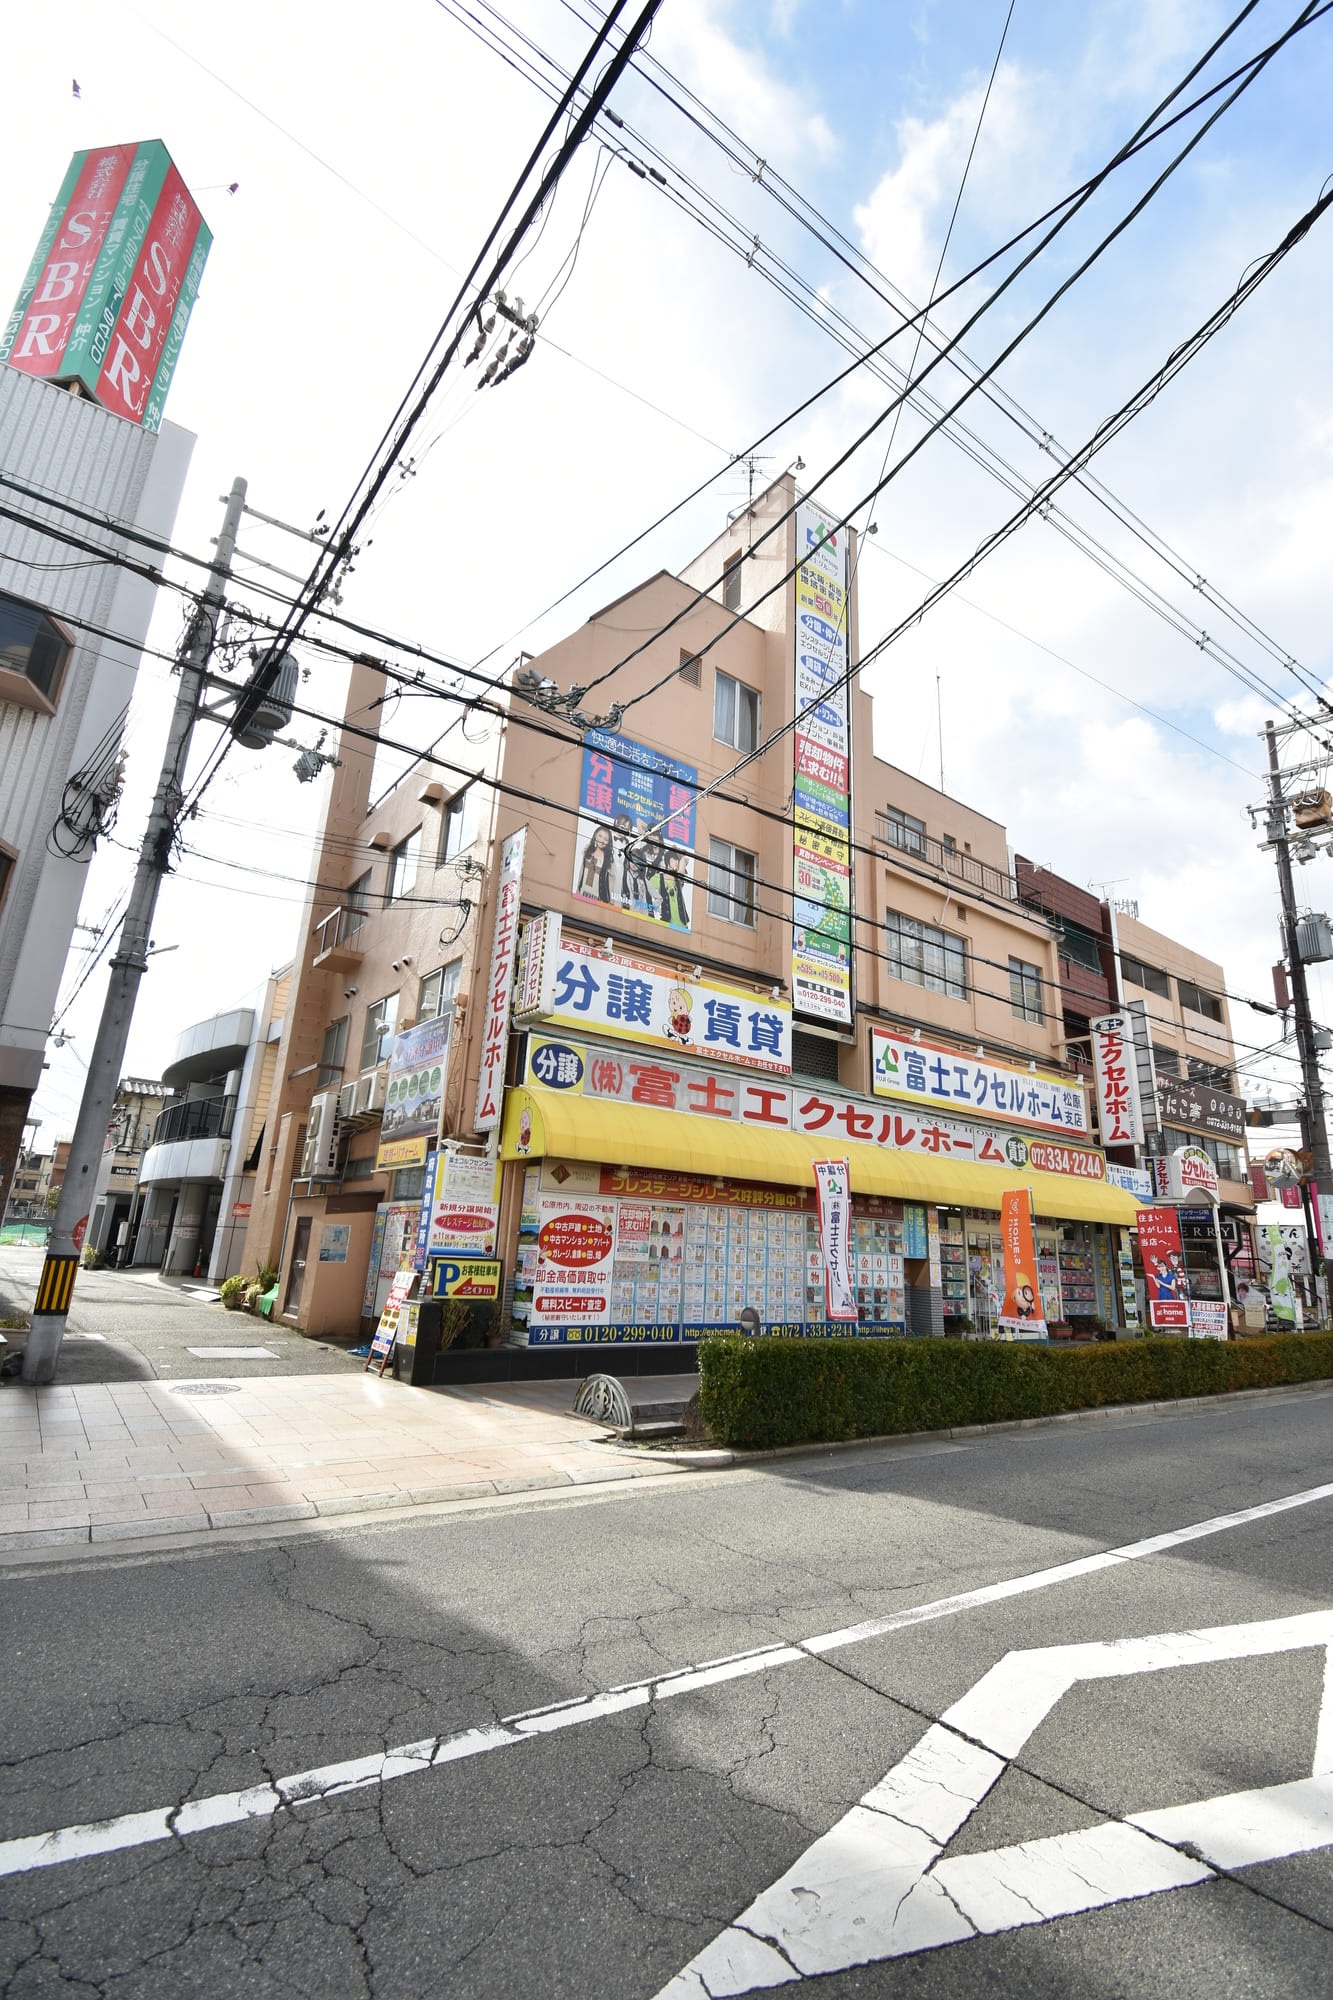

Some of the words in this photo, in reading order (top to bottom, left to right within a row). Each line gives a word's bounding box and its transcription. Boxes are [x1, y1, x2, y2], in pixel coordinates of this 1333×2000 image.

[14, 210, 97, 359] SBR
[105, 241, 171, 411] SBR
[801, 565, 842, 597] 南大阪・松原
[591, 730, 694, 782] 快適生活をデザイン
[799, 739, 844, 773] 売却物件
[586, 753, 613, 814] 分譲
[627, 790, 652, 806] エクセル
[798, 836, 845, 861] 秘密厳守
[798, 869, 812, 890] 30
[527, 919, 543, 1007] 富士エクセル
[479, 879, 518, 1120] 富士エクセルホーム
[556, 960, 654, 1026] 分譲
[703, 999, 784, 1058] 賃貸
[1100, 1019, 1121, 1031] 富士
[537, 1048, 578, 1085] 分譲
[695, 1046, 791, 1074] 富士エクセルホームにお任せ下さい
[904, 1050, 1063, 1122] 富士エクセルホーム
[1099, 1031, 1131, 1141] エクセルホーム
[1063, 1091, 1082, 1110] 松原
[917, 1117, 961, 1131] EXCEL
[965, 1127, 1001, 1140] HOME
[1064, 1110, 1083, 1128] 支店
[1008, 1140, 1027, 1163] 賃貸
[1180, 1159, 1216, 1181] エクセルホーム
[440, 1202, 493, 1214] 新規分譲開始
[1138, 1213, 1164, 1224] 住まい
[554, 1222, 582, 1233] 中古戸建
[587, 1223, 602, 1234] 土地
[1139, 1224, 1178, 1235] さがしは、
[549, 1235, 588, 1246] 中古マンション
[593, 1237, 610, 1247] アパート
[1141, 1237, 1173, 1248] 当店へ。
[434, 1263, 460, 1297] P
[462, 1265, 498, 1277] お客様駐車場
[810, 1271, 820, 1284] 物
[462, 1286, 492, 1295] 20m
[541, 1298, 603, 1311] 無料スピード査定
[1163, 1308, 1185, 1316] home
[539, 1328, 560, 1341] 分譲
